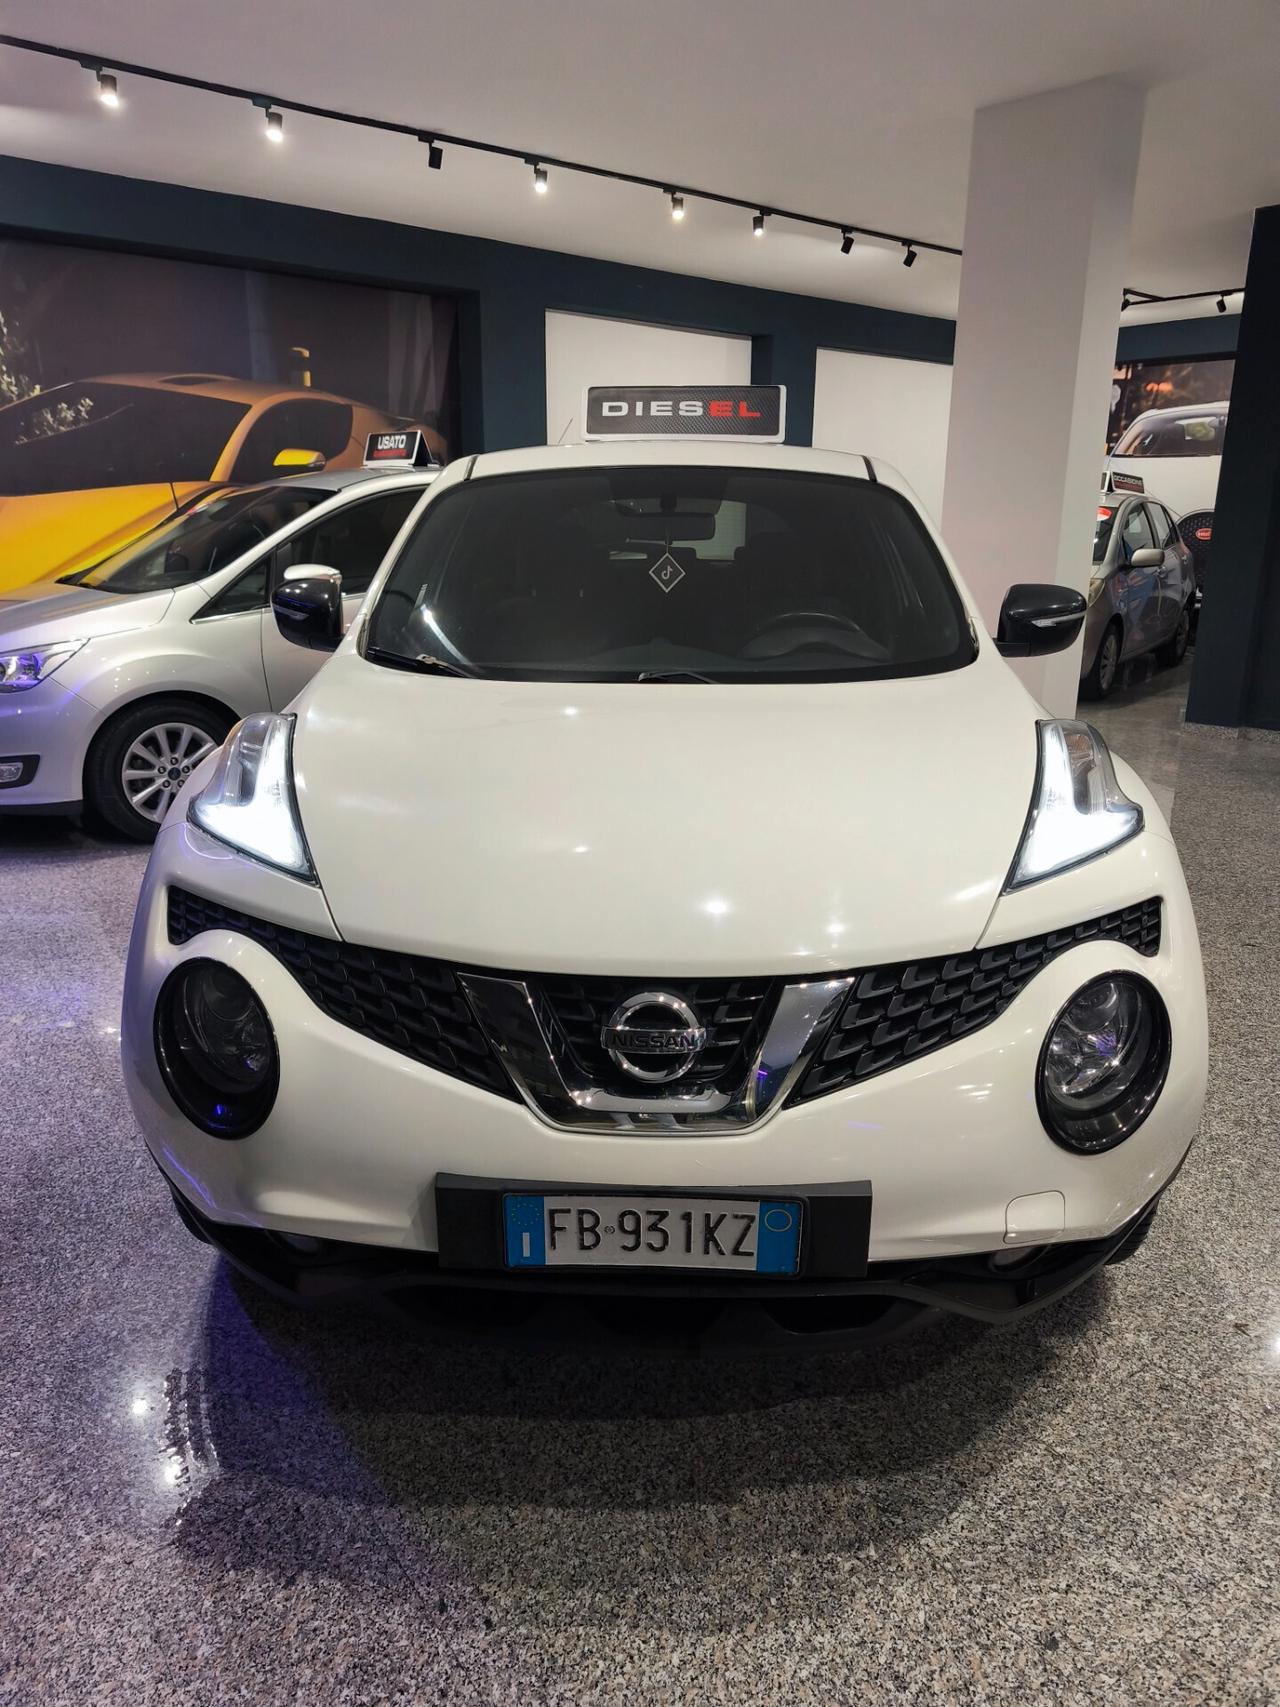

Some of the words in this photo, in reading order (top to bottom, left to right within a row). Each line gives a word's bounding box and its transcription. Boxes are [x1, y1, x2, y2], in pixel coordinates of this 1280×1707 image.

[601, 400, 761, 417] DIESEL
[377, 434, 407, 450] USATO
[611, 1033, 695, 1050] NISSAN
